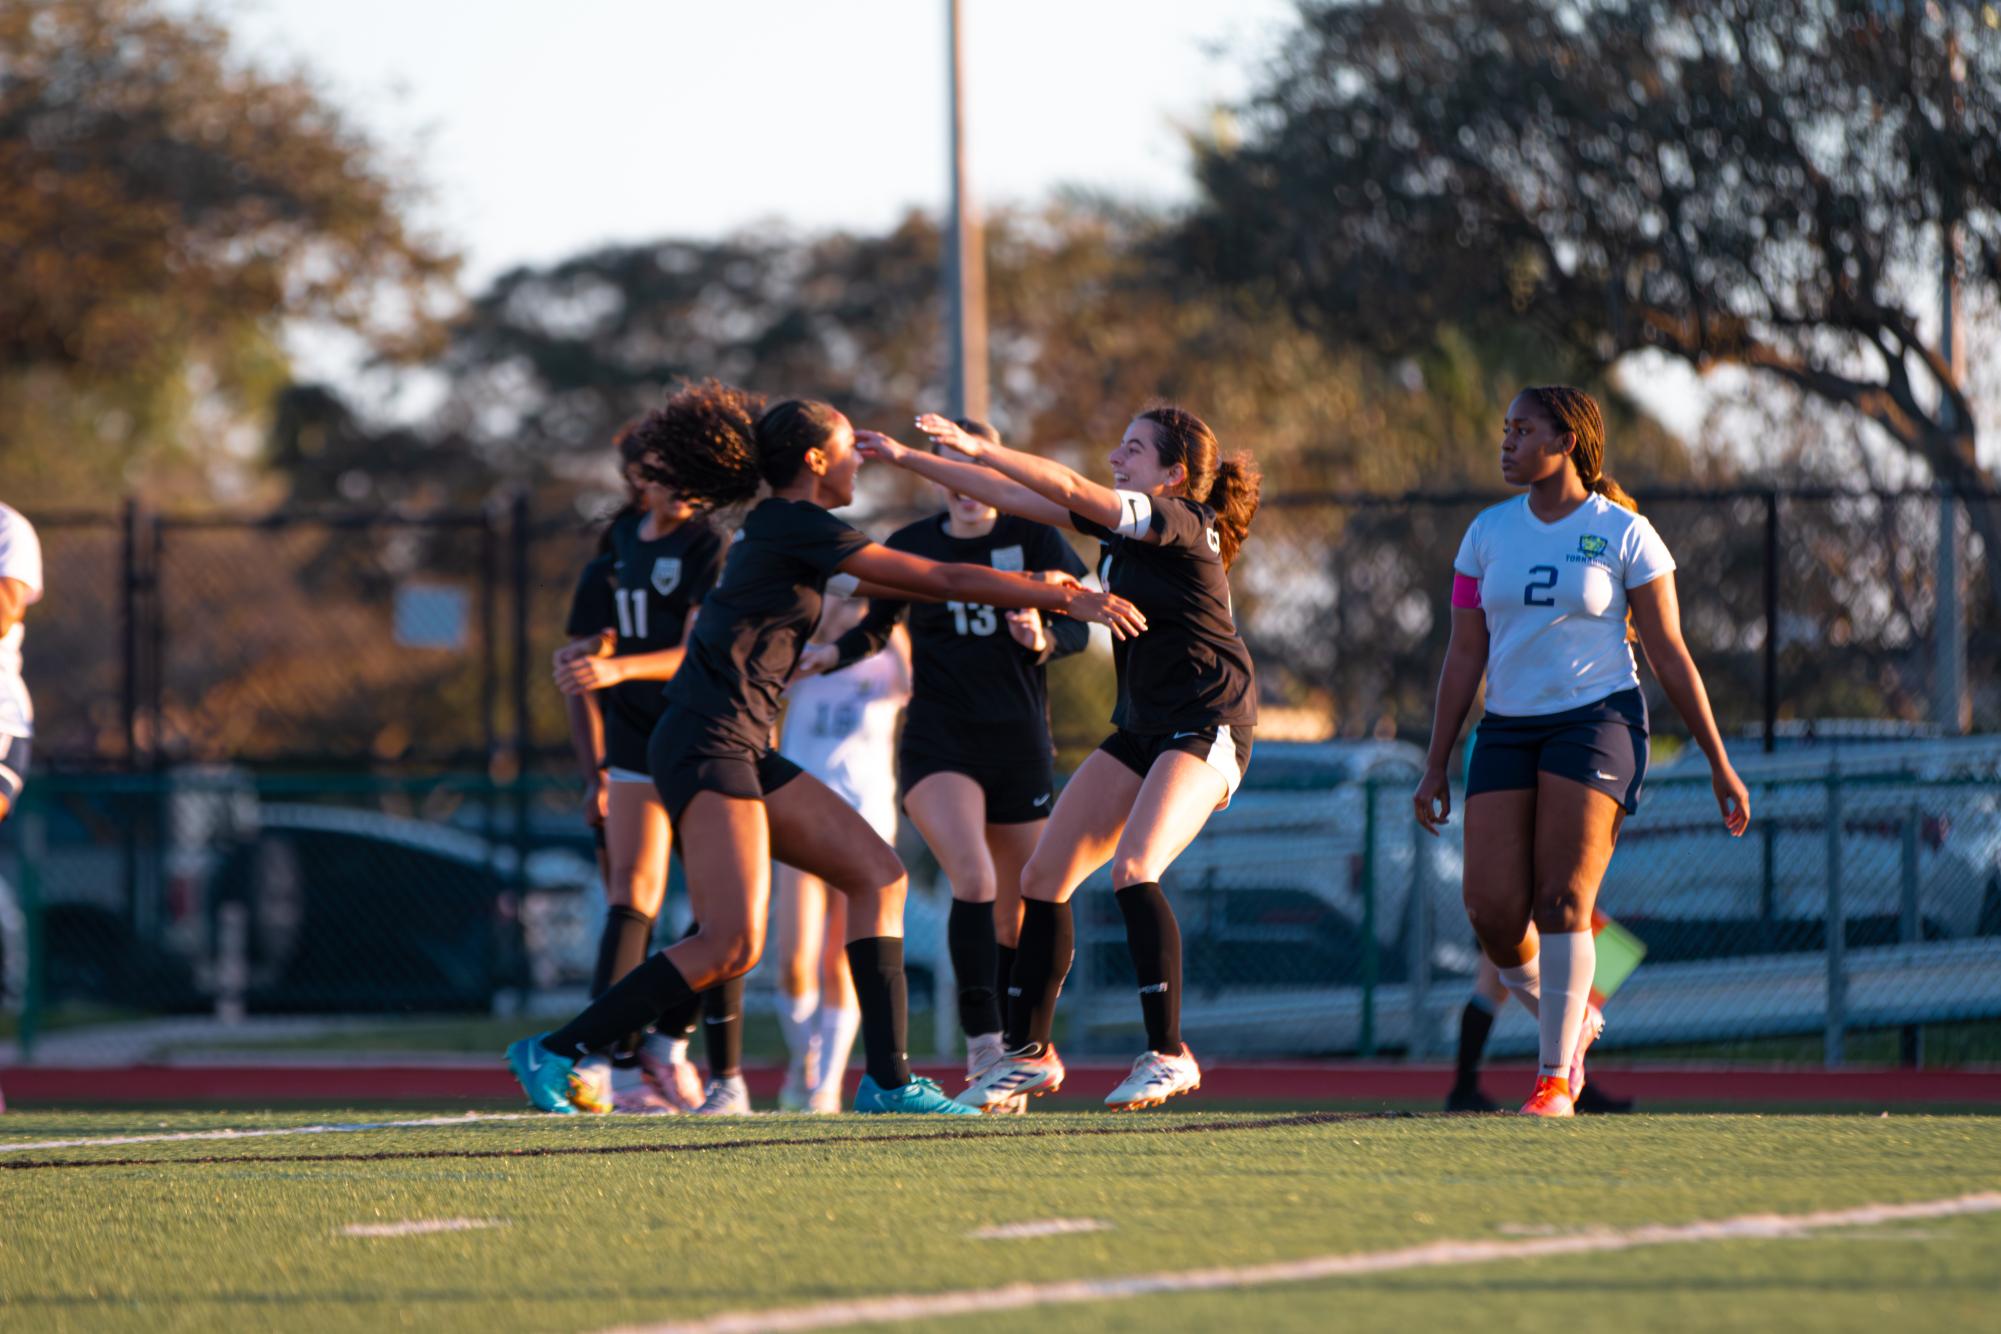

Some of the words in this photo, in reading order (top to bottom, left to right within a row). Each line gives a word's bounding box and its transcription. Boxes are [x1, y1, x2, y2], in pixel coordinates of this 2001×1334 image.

[1524, 565, 1559, 607] 2
[615, 588, 648, 639] 11
[946, 601, 998, 636] 13
